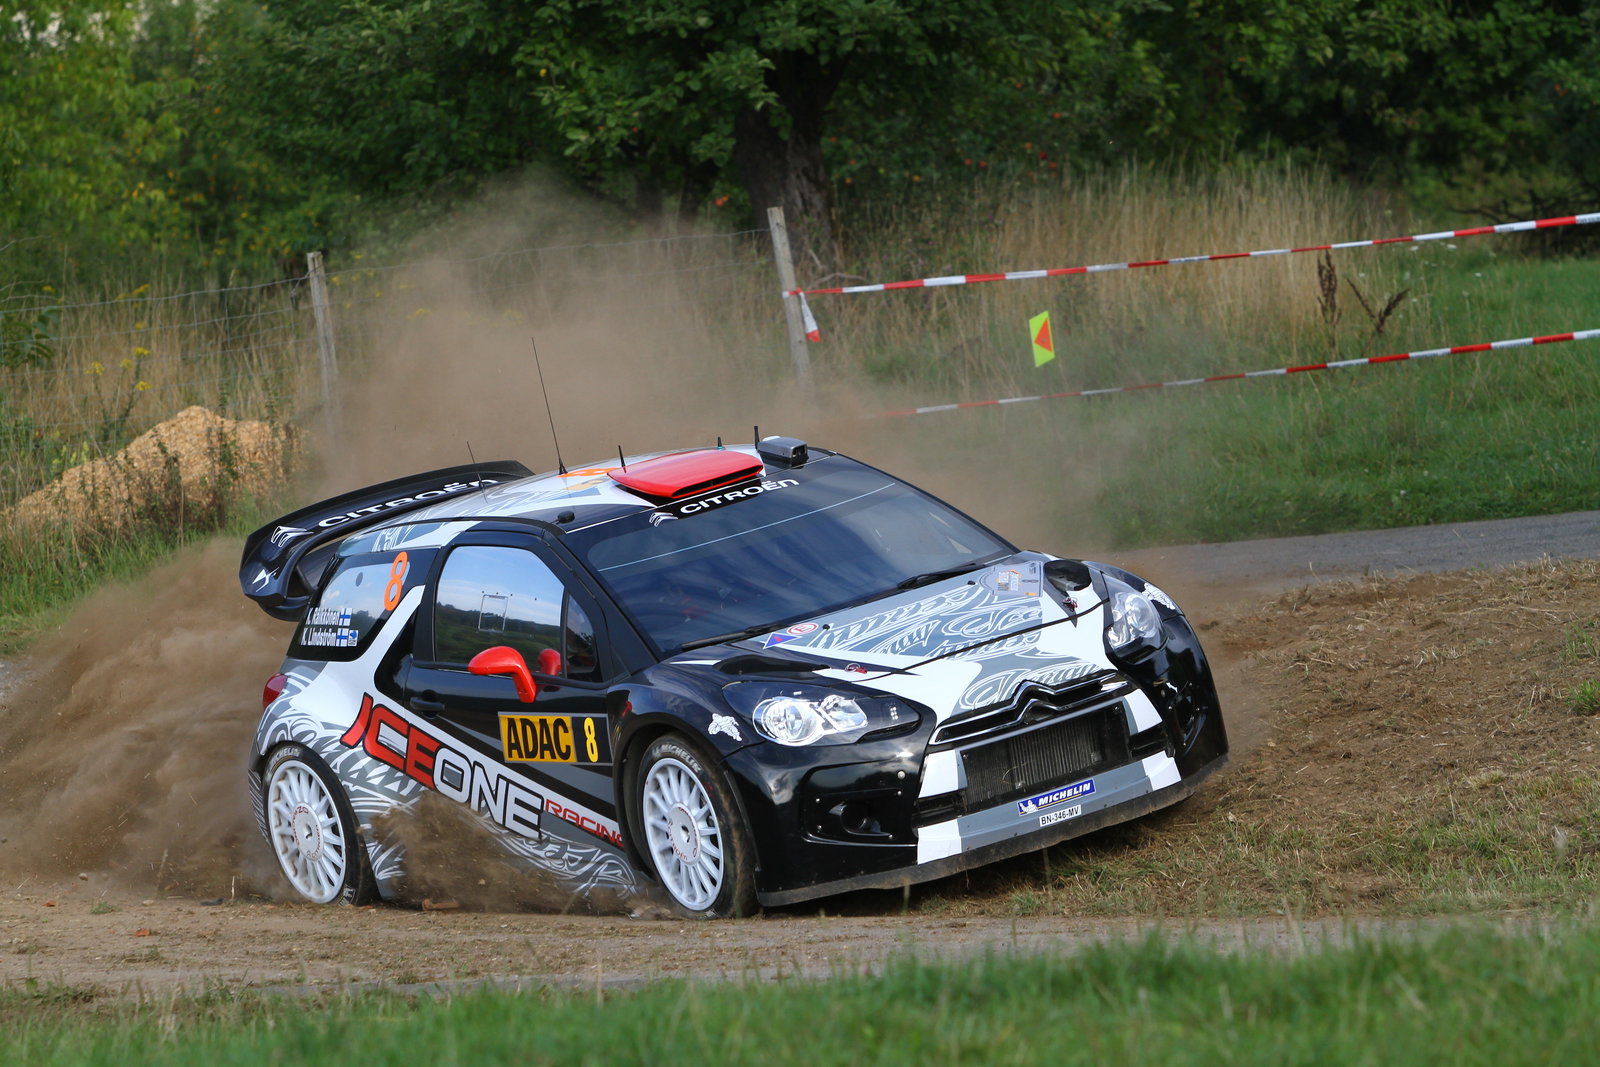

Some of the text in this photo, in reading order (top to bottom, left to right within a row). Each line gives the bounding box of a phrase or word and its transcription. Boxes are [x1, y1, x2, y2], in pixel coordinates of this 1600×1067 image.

[383, 551, 408, 611] 8
[507, 717, 599, 763] ADAC 8
[1038, 782, 1091, 806] MICHELIN
[1040, 806, 1080, 826] BN-346-MV
